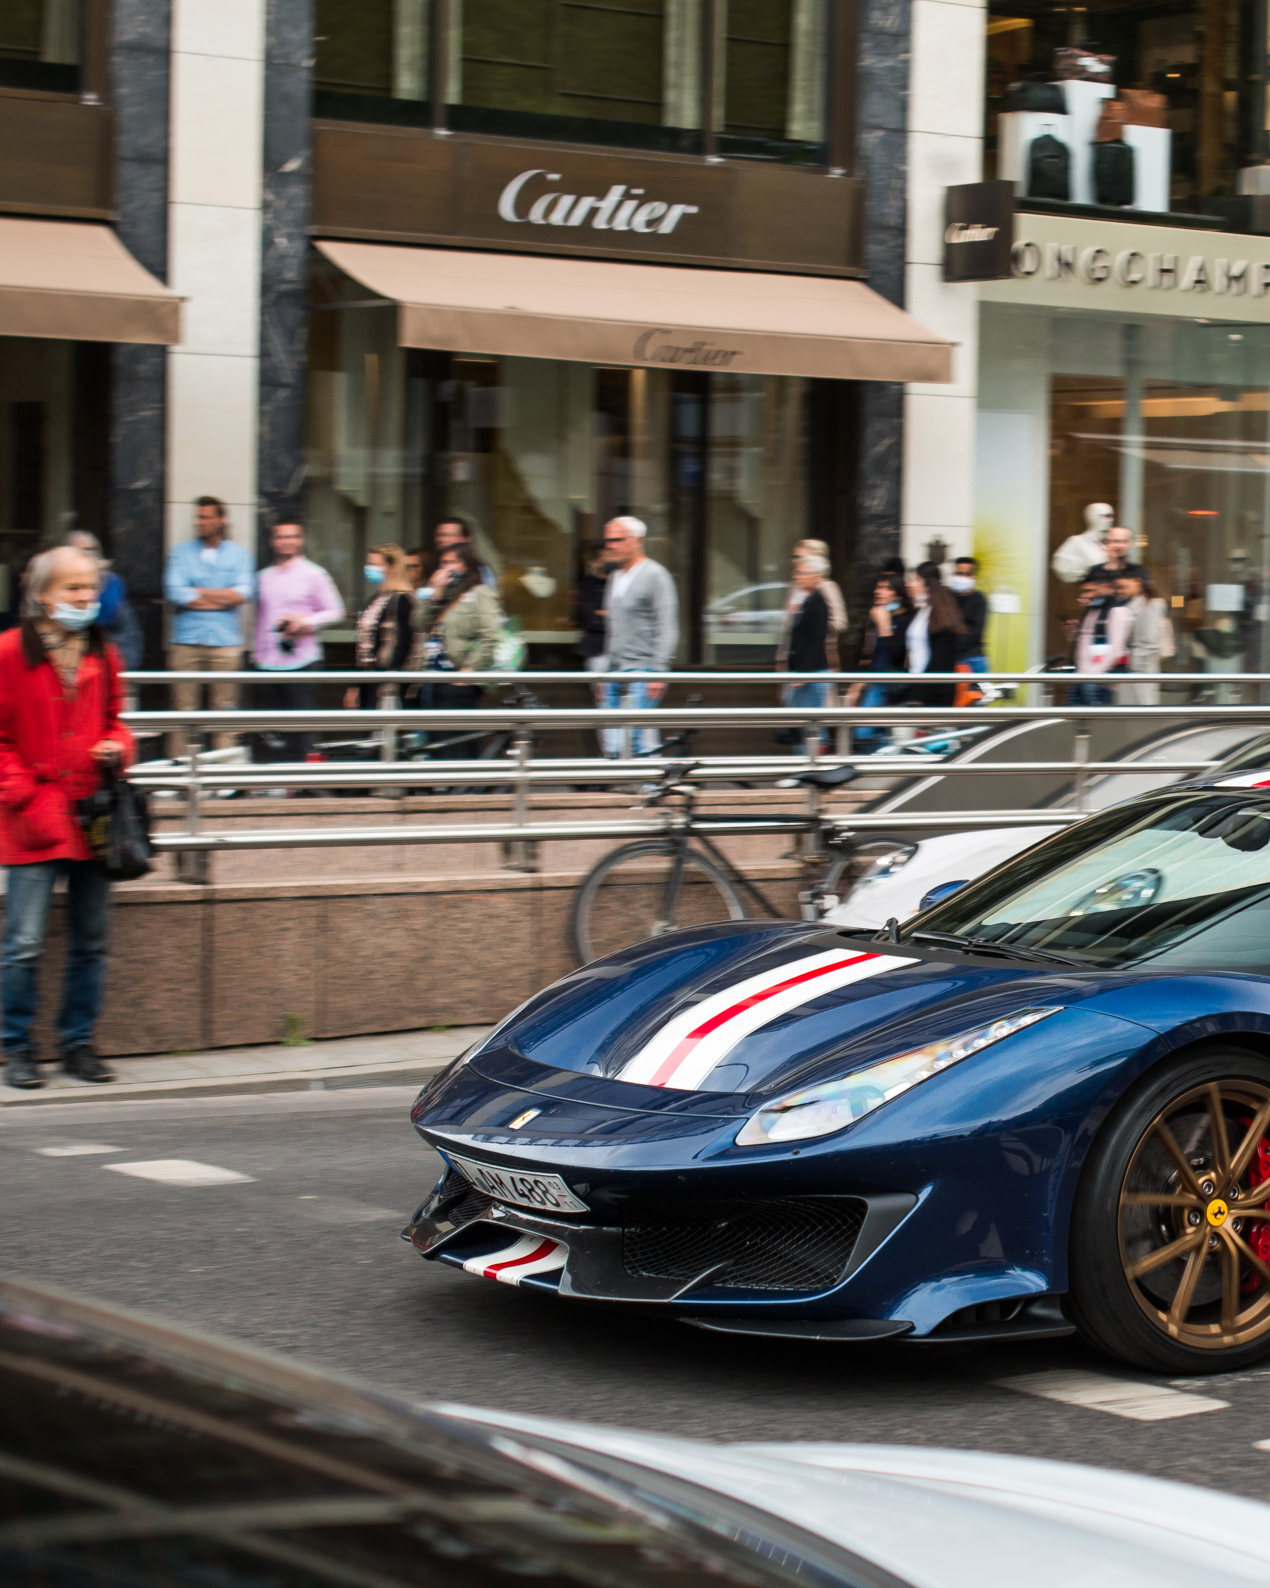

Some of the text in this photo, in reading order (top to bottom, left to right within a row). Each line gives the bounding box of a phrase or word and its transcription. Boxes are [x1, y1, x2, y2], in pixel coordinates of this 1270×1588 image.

[498, 169, 699, 234] Cartier
[632, 328, 744, 367] Cartier
[477, 1167, 517, 1200] AM
[509, 1175, 561, 1208] 488
